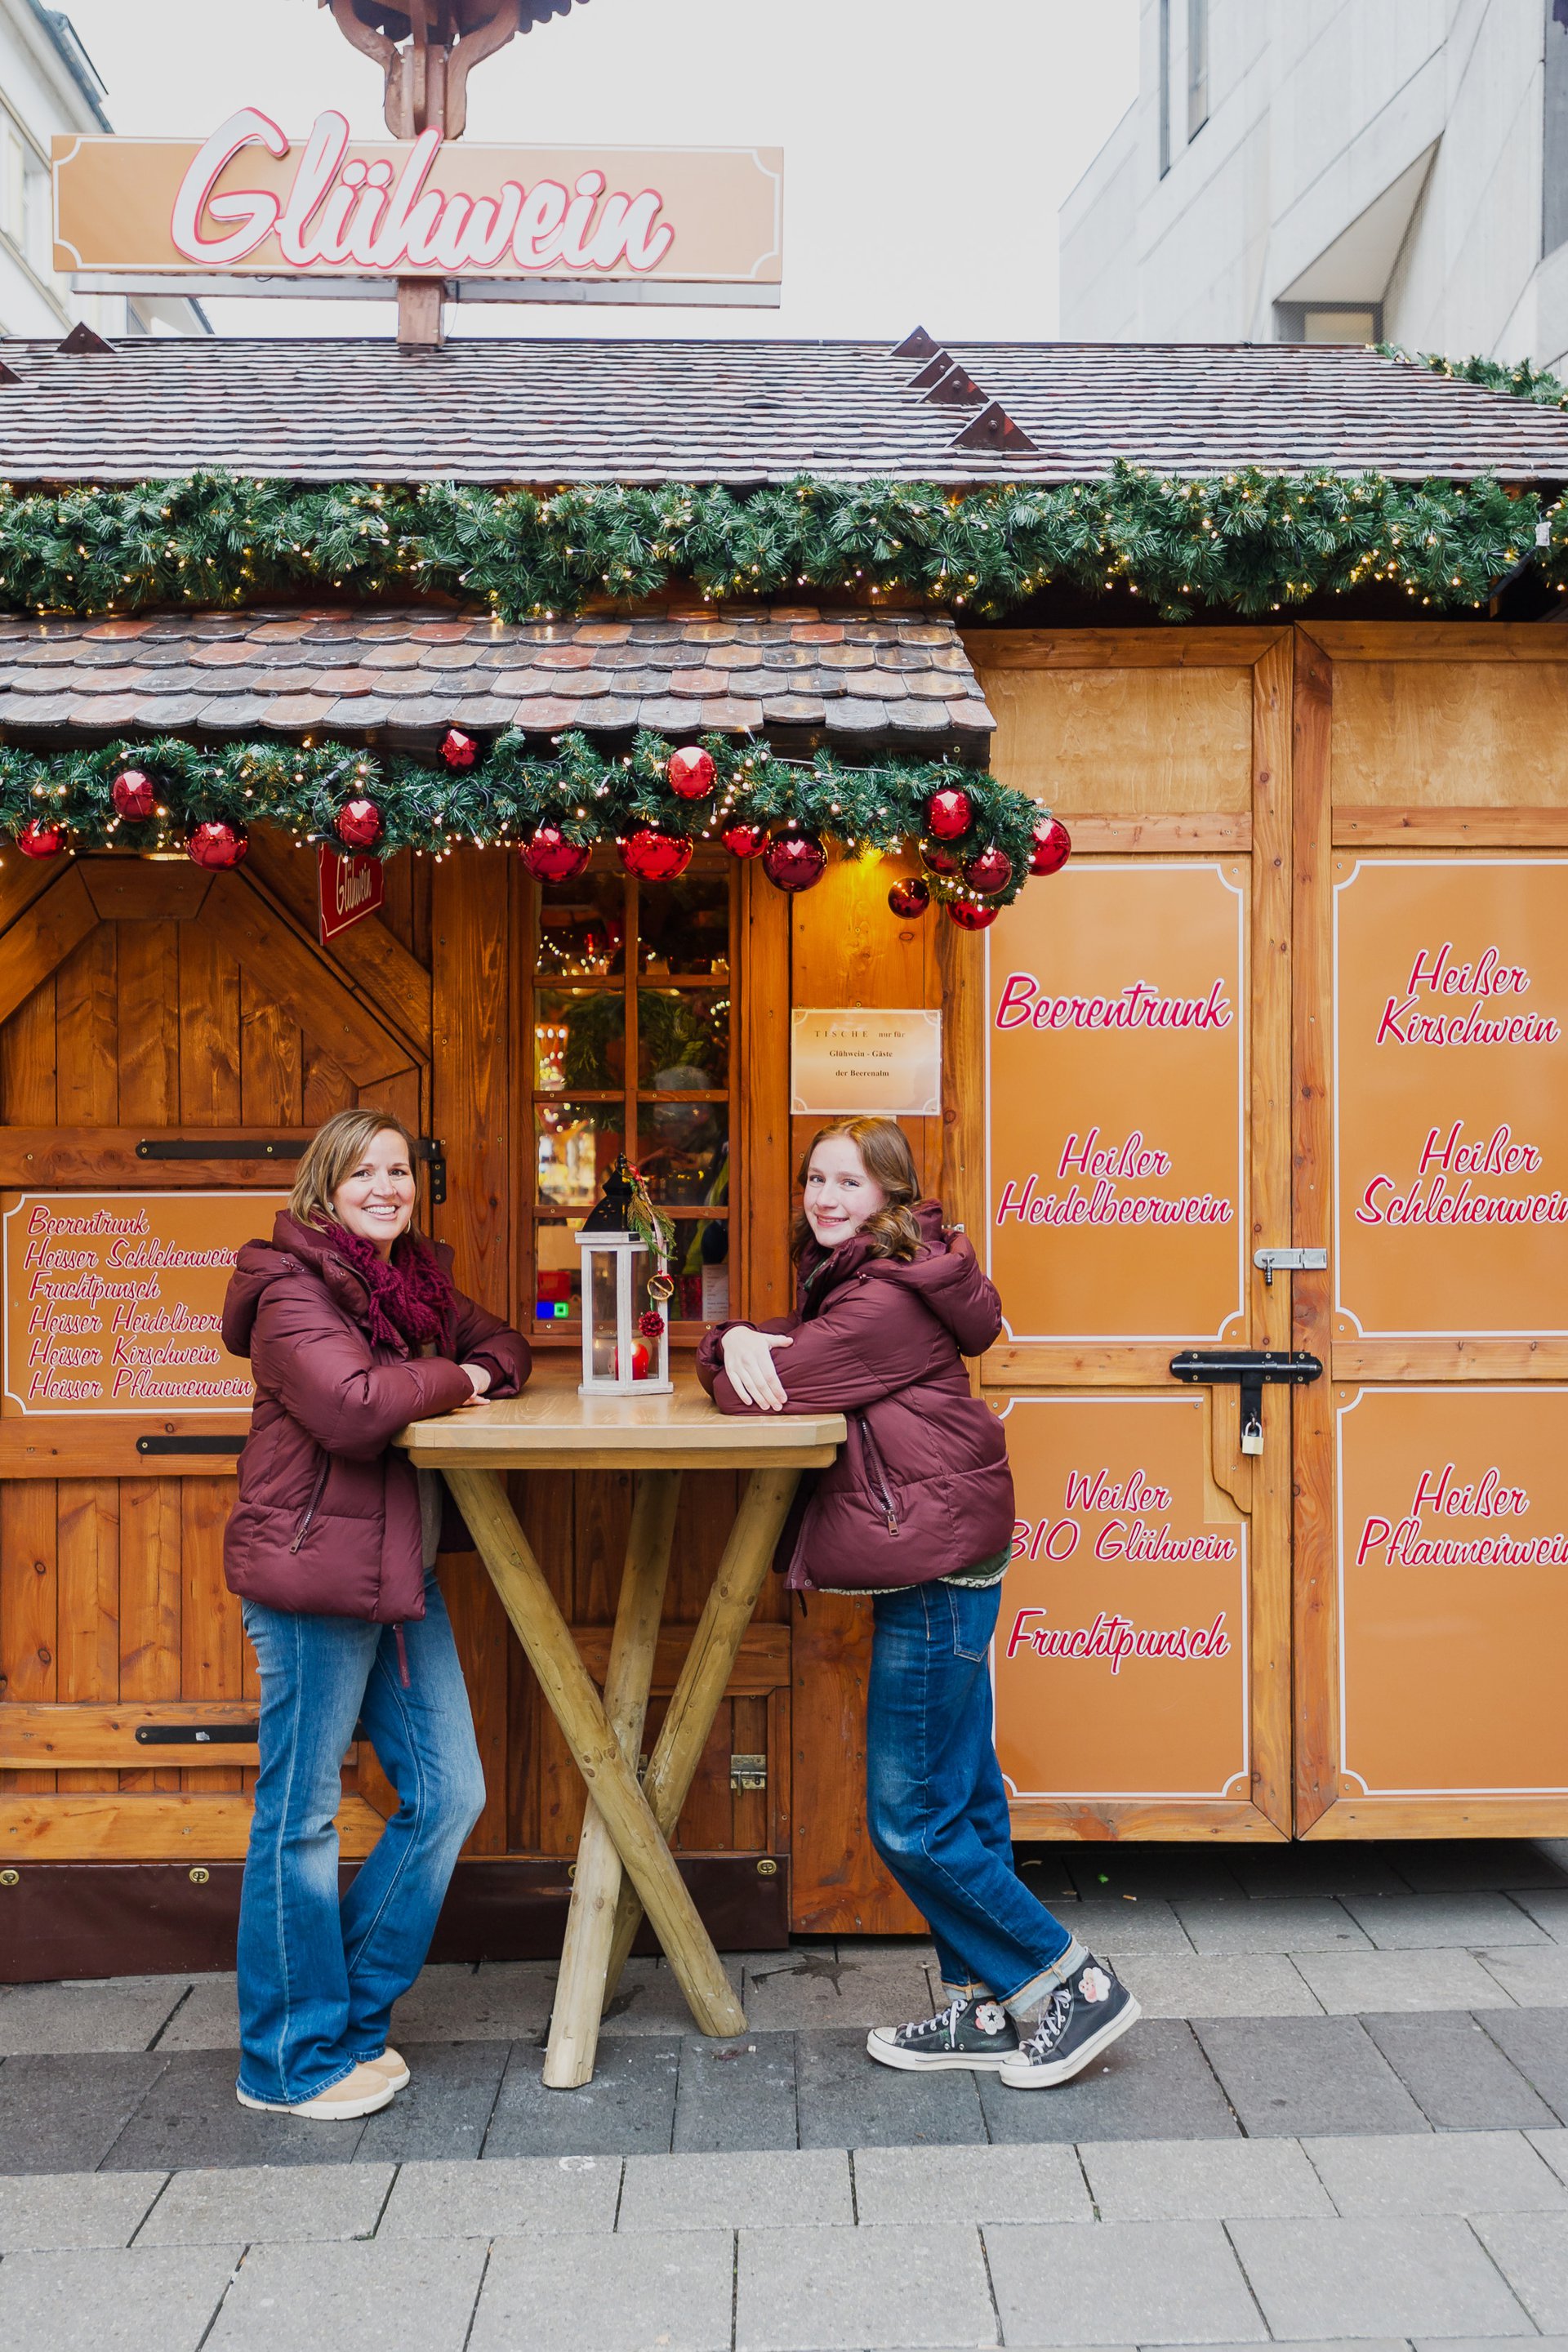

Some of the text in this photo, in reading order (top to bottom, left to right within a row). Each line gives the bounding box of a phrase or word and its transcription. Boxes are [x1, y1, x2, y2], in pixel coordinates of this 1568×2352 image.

[170, 105, 675, 274] Glühwein
[1406, 942, 1530, 998] Heißer
[994, 972, 1234, 1031] Beerentrunk
[1375, 995, 1561, 1046] Kirschwein
[1057, 1126, 1171, 1178] Heißer
[1418, 1120, 1543, 1177] Heißer
[27, 1205, 149, 1236] Beerentrunk
[996, 1173, 1234, 1227] Heidelbeerwein
[1355, 1174, 1568, 1225] Schlehenwei
[24, 1238, 99, 1270] Heisser
[28, 1271, 161, 1309] Fruchtpunsch
[28, 1302, 103, 1334] Heisser
[28, 1334, 220, 1367] Heisser Kirschwein
[28, 1367, 254, 1400] Heisser Pflaumenwein
[1065, 1468, 1173, 1512] Weißer
[1410, 1463, 1530, 1518] Heißer
[1094, 1518, 1237, 1562] Glühwein
[1356, 1516, 1568, 1567] Pflaumenwei
[1005, 1607, 1232, 1675] Fruchtpunsch
